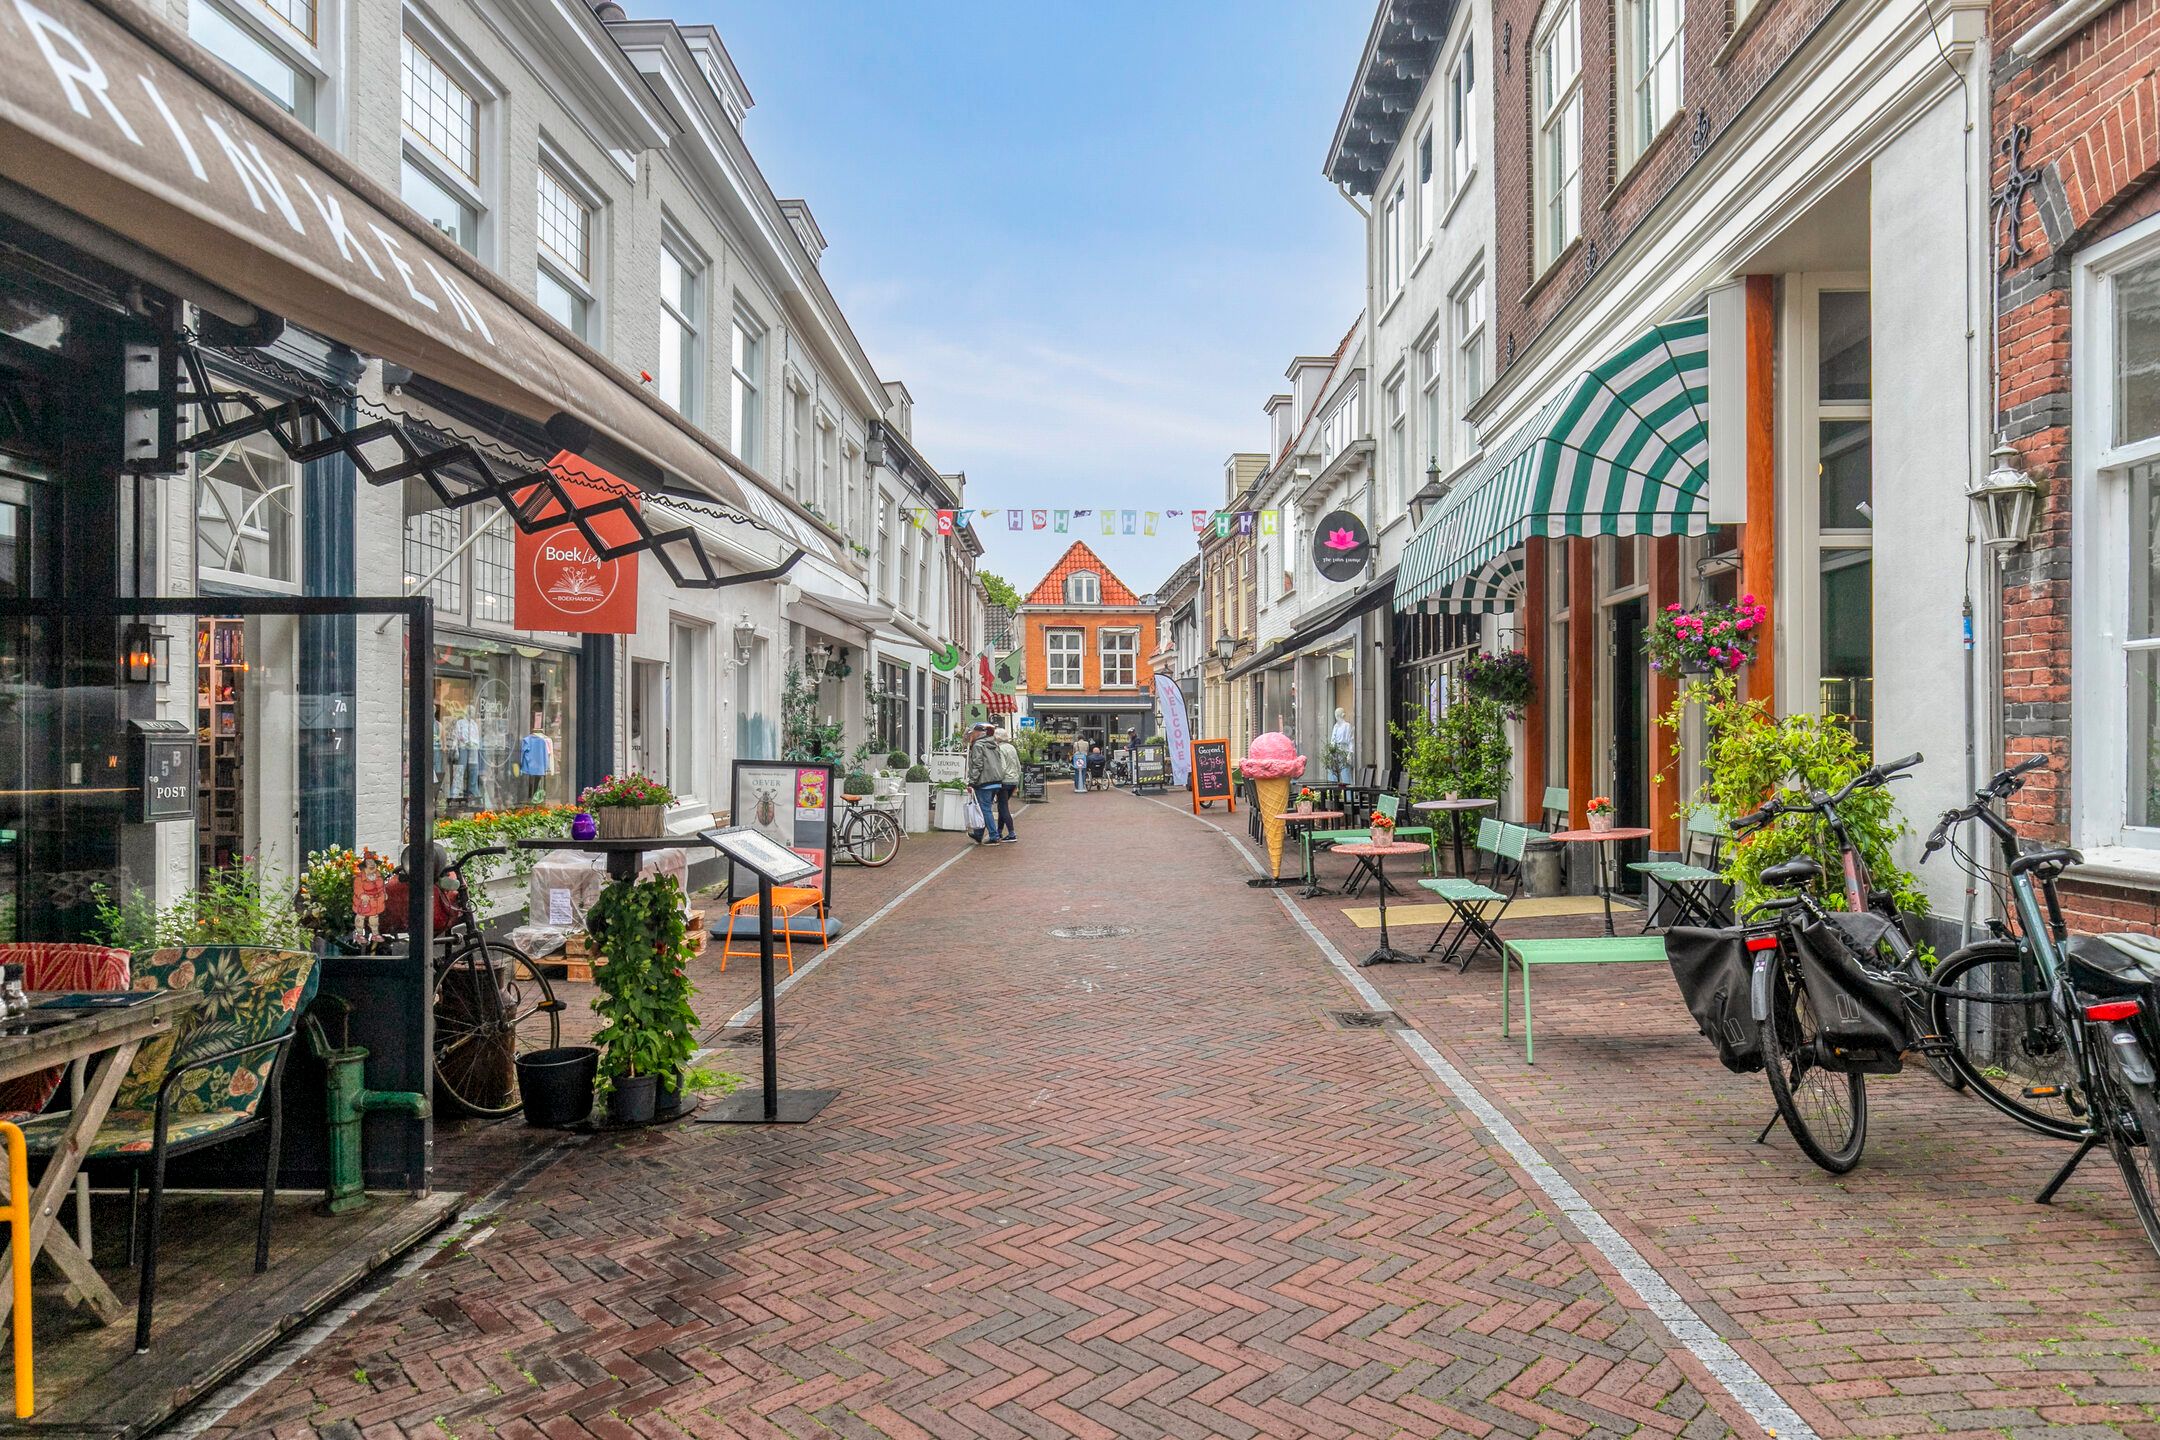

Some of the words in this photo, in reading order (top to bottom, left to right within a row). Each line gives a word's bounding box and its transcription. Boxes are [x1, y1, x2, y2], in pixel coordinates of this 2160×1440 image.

[546, 546, 582, 561] Boek
[334, 699, 347, 713] 7A
[1163, 685, 1185, 761] WELCOME
[334, 737, 342, 750] 7
[161, 760, 169, 777] 5
[172, 750, 181, 767] B
[156, 786, 187, 799] POST
